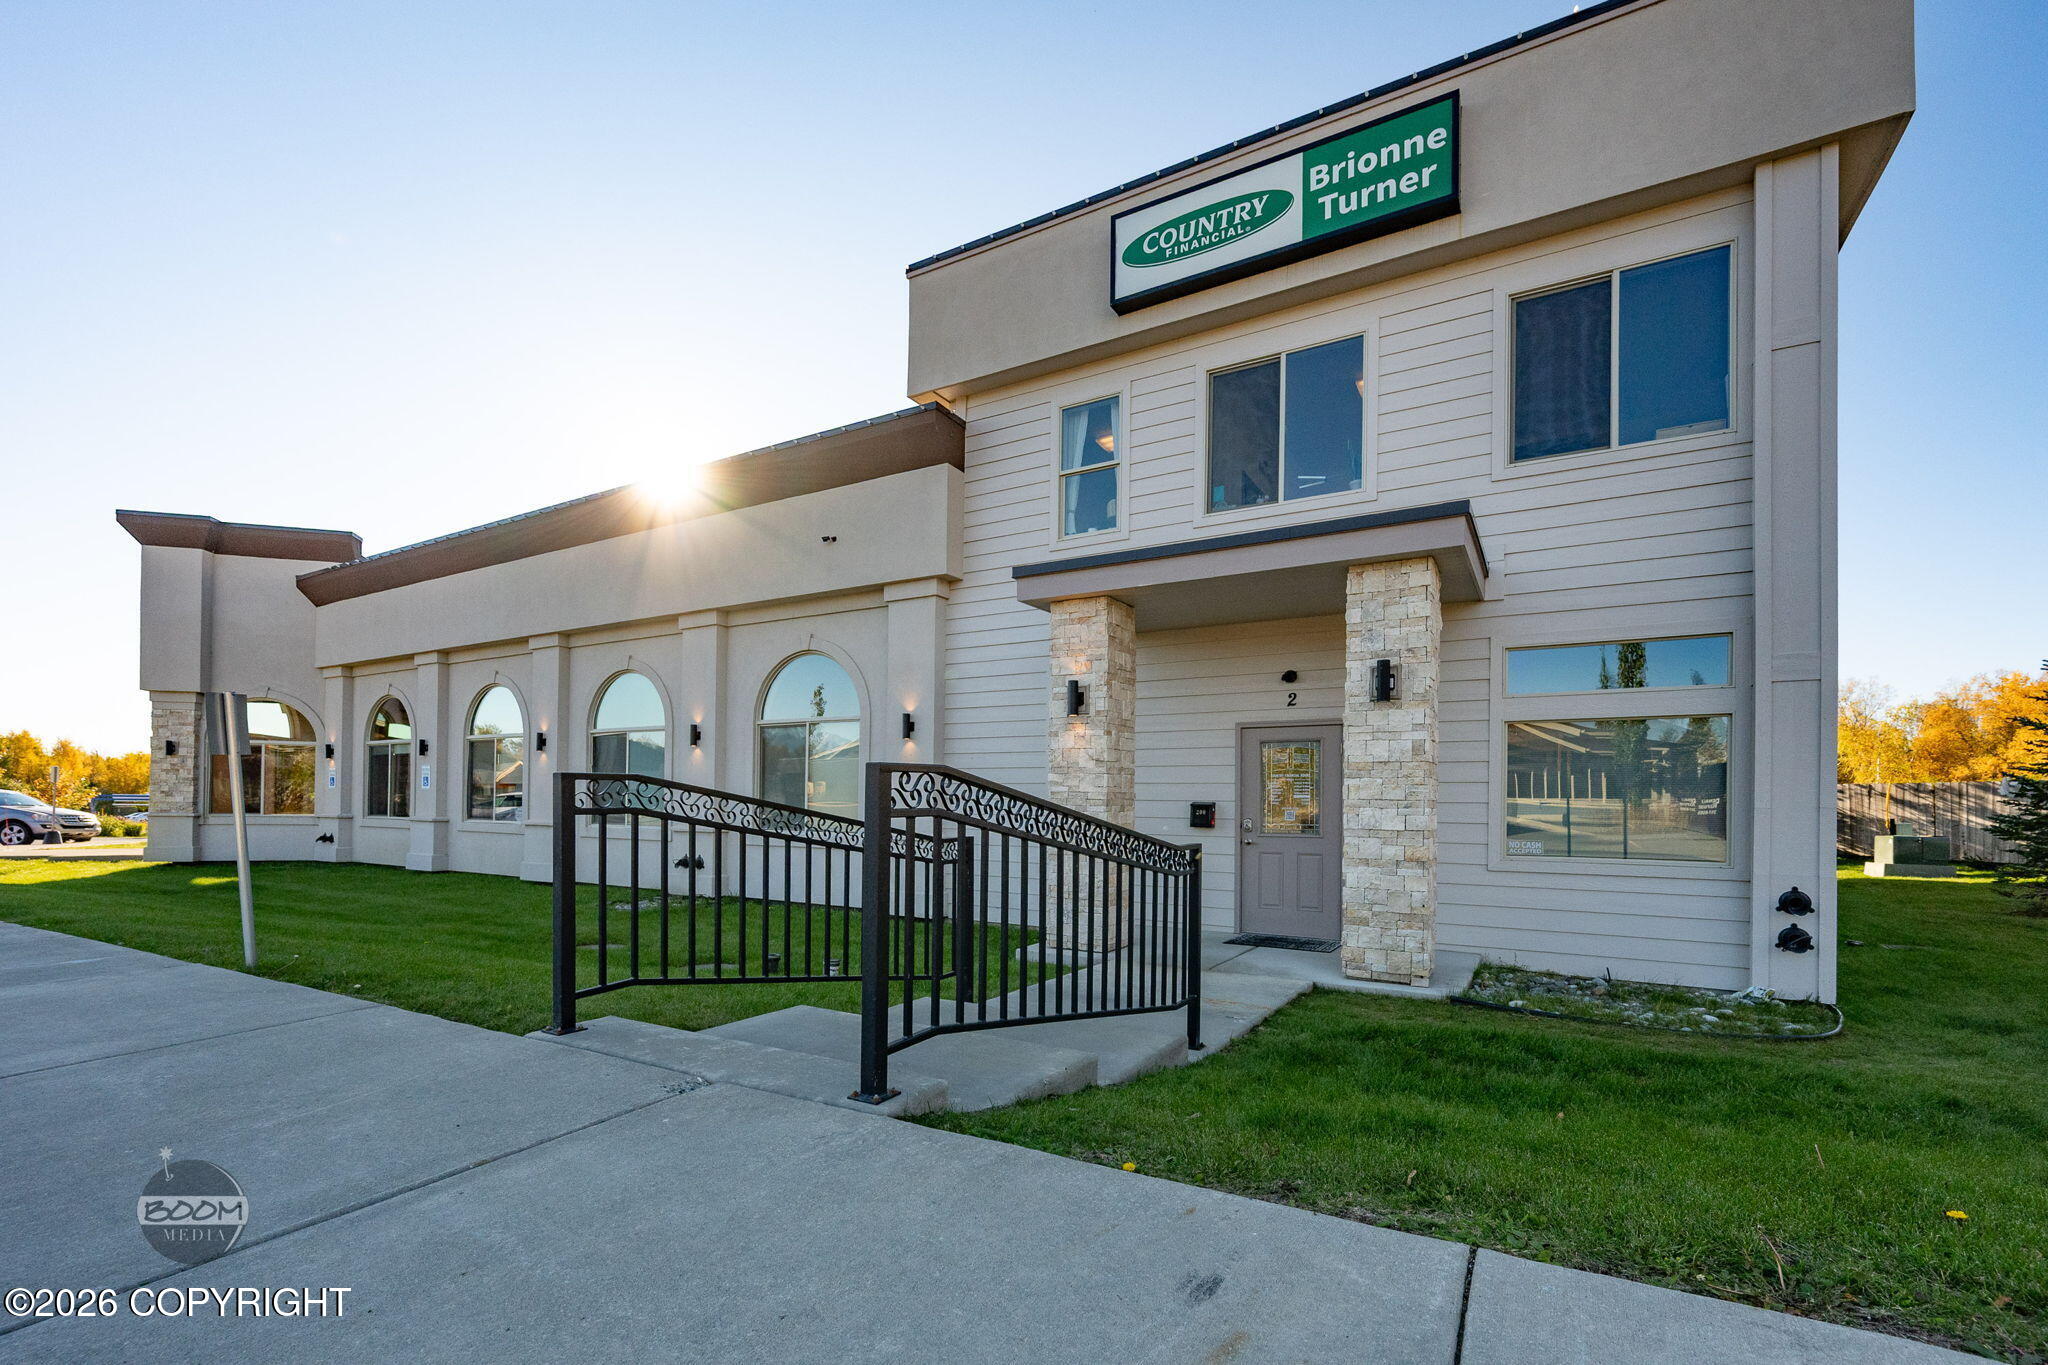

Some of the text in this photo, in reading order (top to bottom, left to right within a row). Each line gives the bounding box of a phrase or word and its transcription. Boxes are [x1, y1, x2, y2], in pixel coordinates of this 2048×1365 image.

[1309, 127, 1447, 192] Brionne
[1318, 163, 1438, 220] Turner
[1142, 194, 1270, 254] COUNTRY
[1287, 692, 1297, 707] 2
[1522, 841, 1542, 849] CASH
